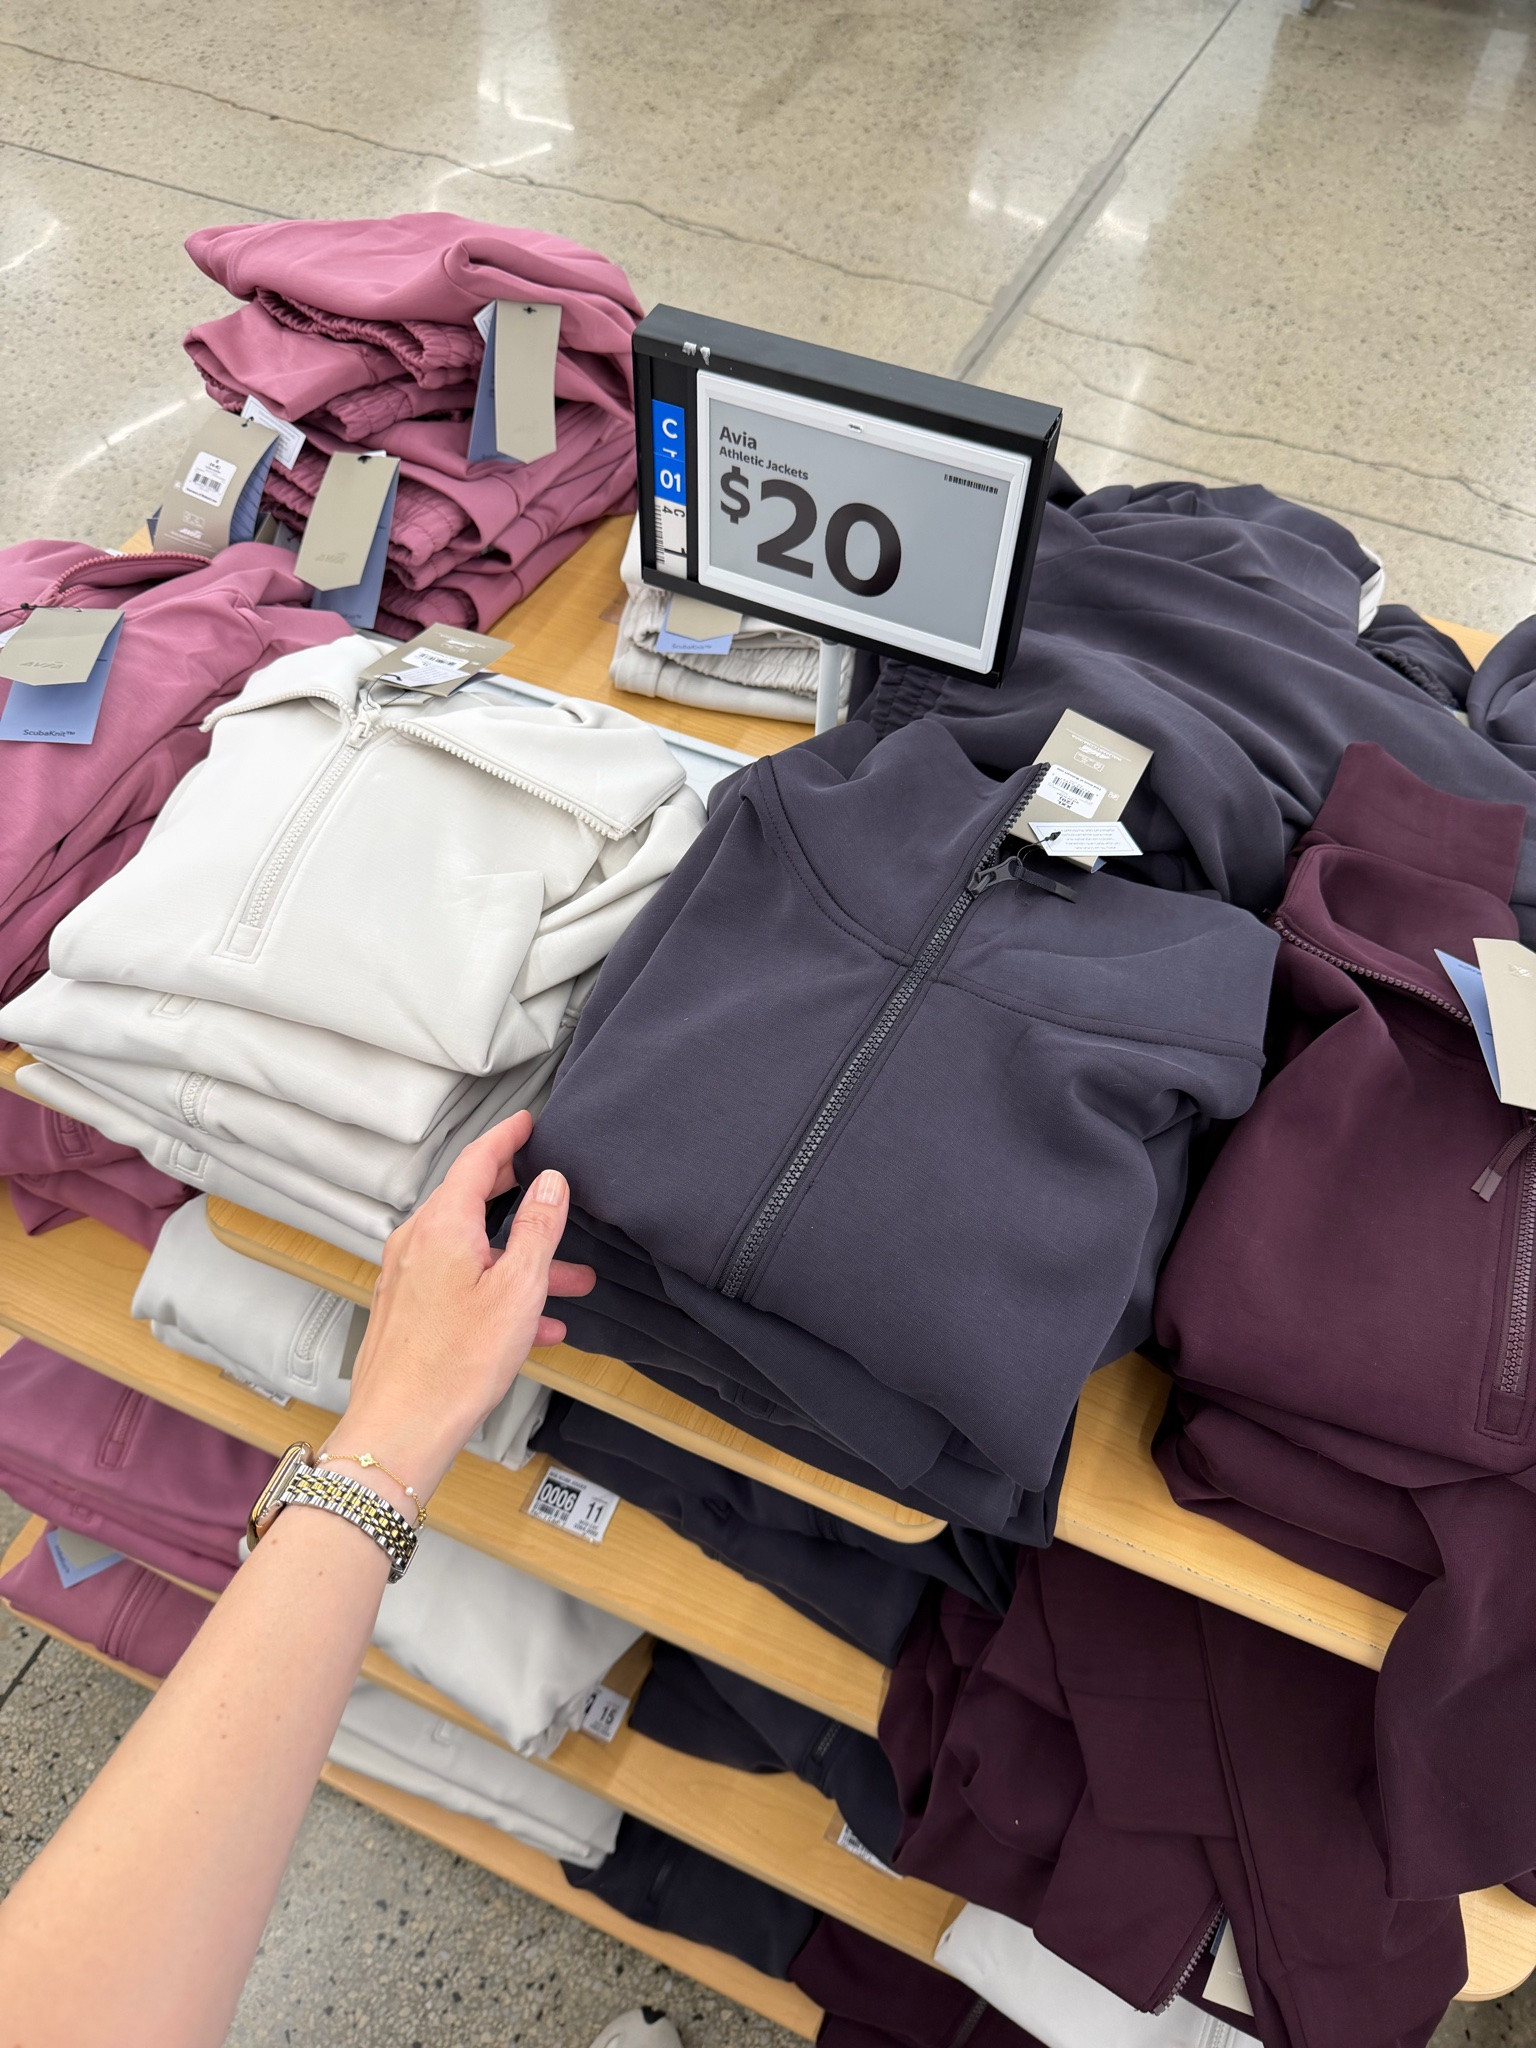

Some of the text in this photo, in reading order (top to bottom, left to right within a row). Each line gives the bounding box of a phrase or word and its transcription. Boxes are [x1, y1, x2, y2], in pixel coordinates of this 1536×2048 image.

[719, 426, 757, 450] Avia
[719, 446, 809, 480] Athletic Jackets
[660, 469, 681, 493] 01
[720, 465, 902, 598] $20
[540, 1483, 577, 1512] 0006
[585, 1501, 604, 1523] 11
